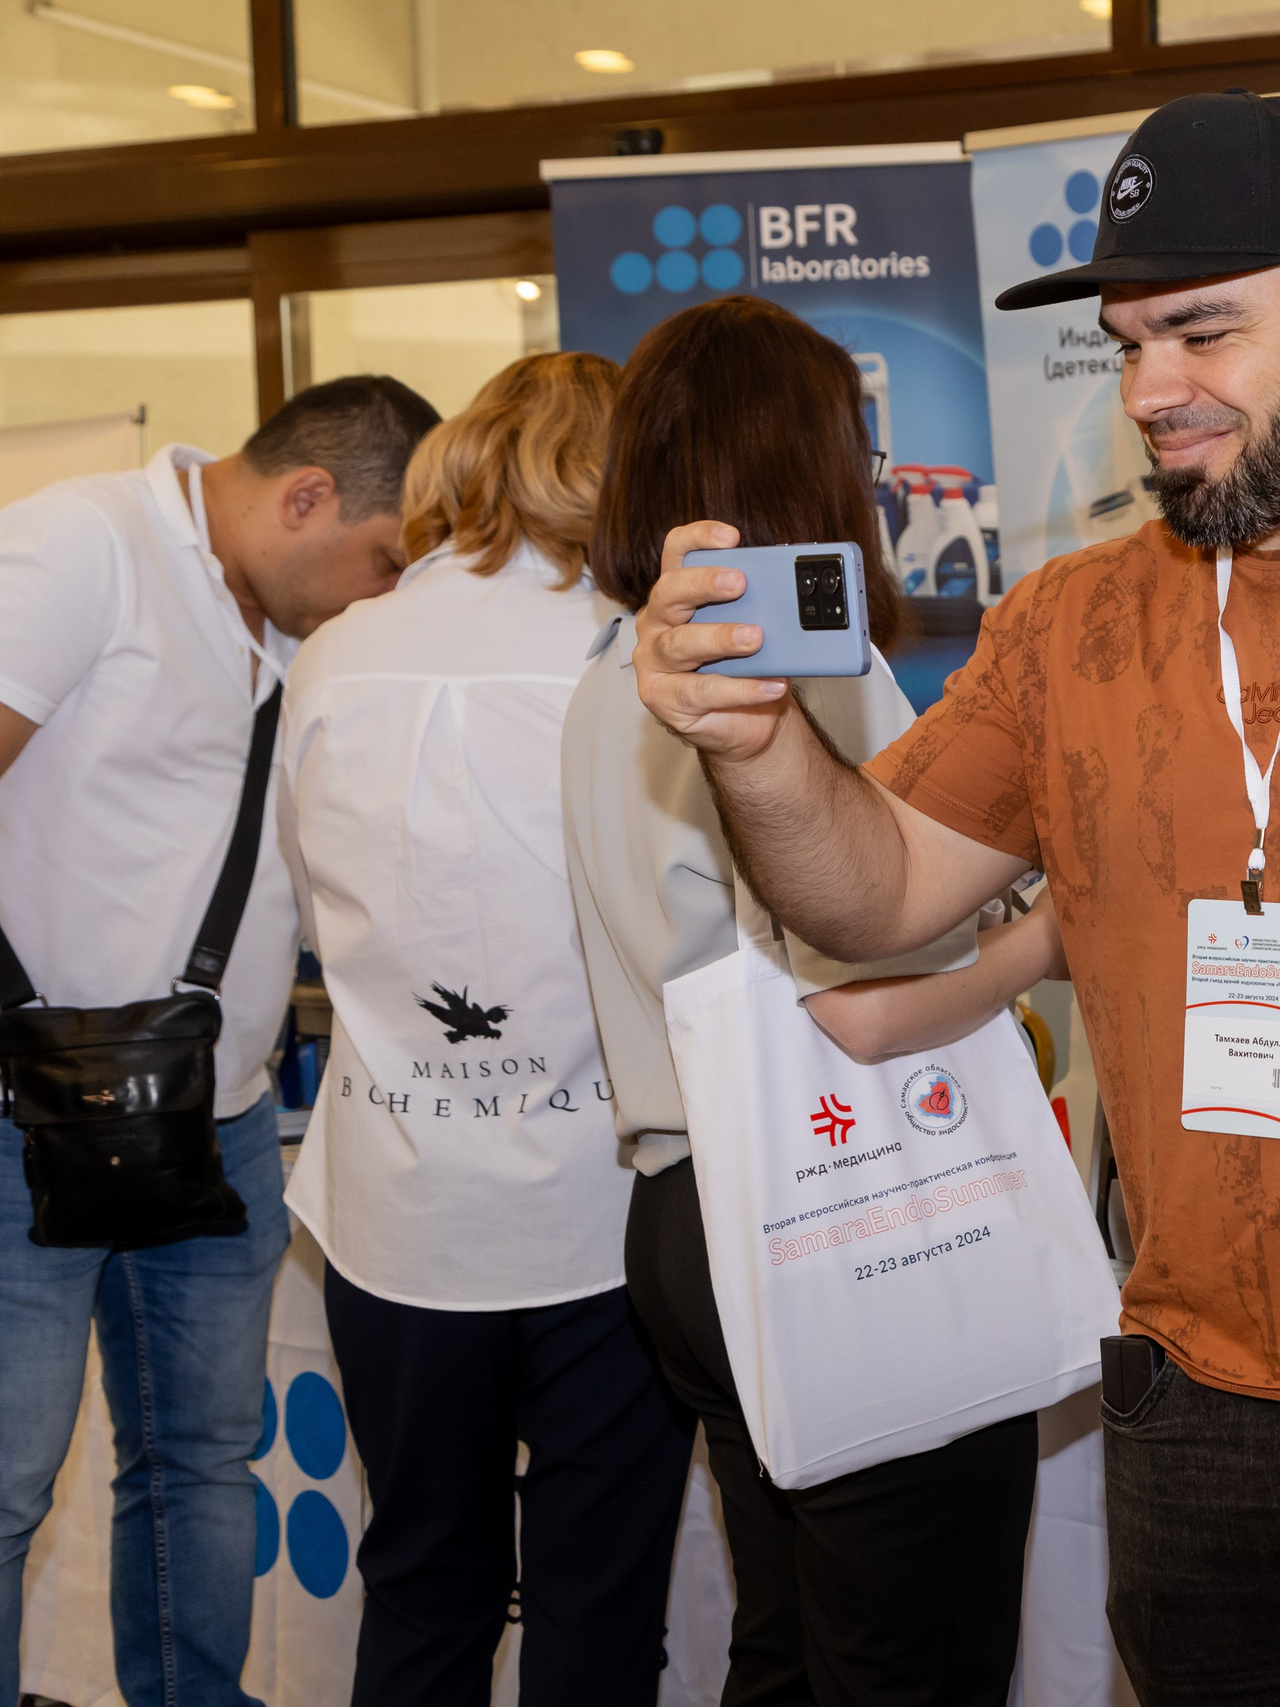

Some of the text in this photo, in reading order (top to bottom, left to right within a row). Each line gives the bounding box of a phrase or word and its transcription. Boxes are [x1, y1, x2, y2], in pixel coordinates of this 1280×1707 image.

[1120, 176, 1138, 190] NIKE
[1130, 189, 1139, 198] SB
[759, 203, 859, 249] BFR
[761, 251, 931, 283] laboratories
[1058, 326, 1108, 348] Инд
[1215, 1034, 1250, 1045] Тамхаев
[1228, 1048, 1274, 1059] Вахитович
[411, 1057, 546, 1079] MAISON
[905, 1111, 936, 1136] общество
[763, 1216, 797, 1234] Вторая
[799, 1194, 870, 1222] всероссийская
[872, 1161, 973, 1201] научно-практическая
[768, 1169, 1028, 1266] SamaraEndoSummer
[855, 1225, 991, 1280] 22-23 августа 2024
